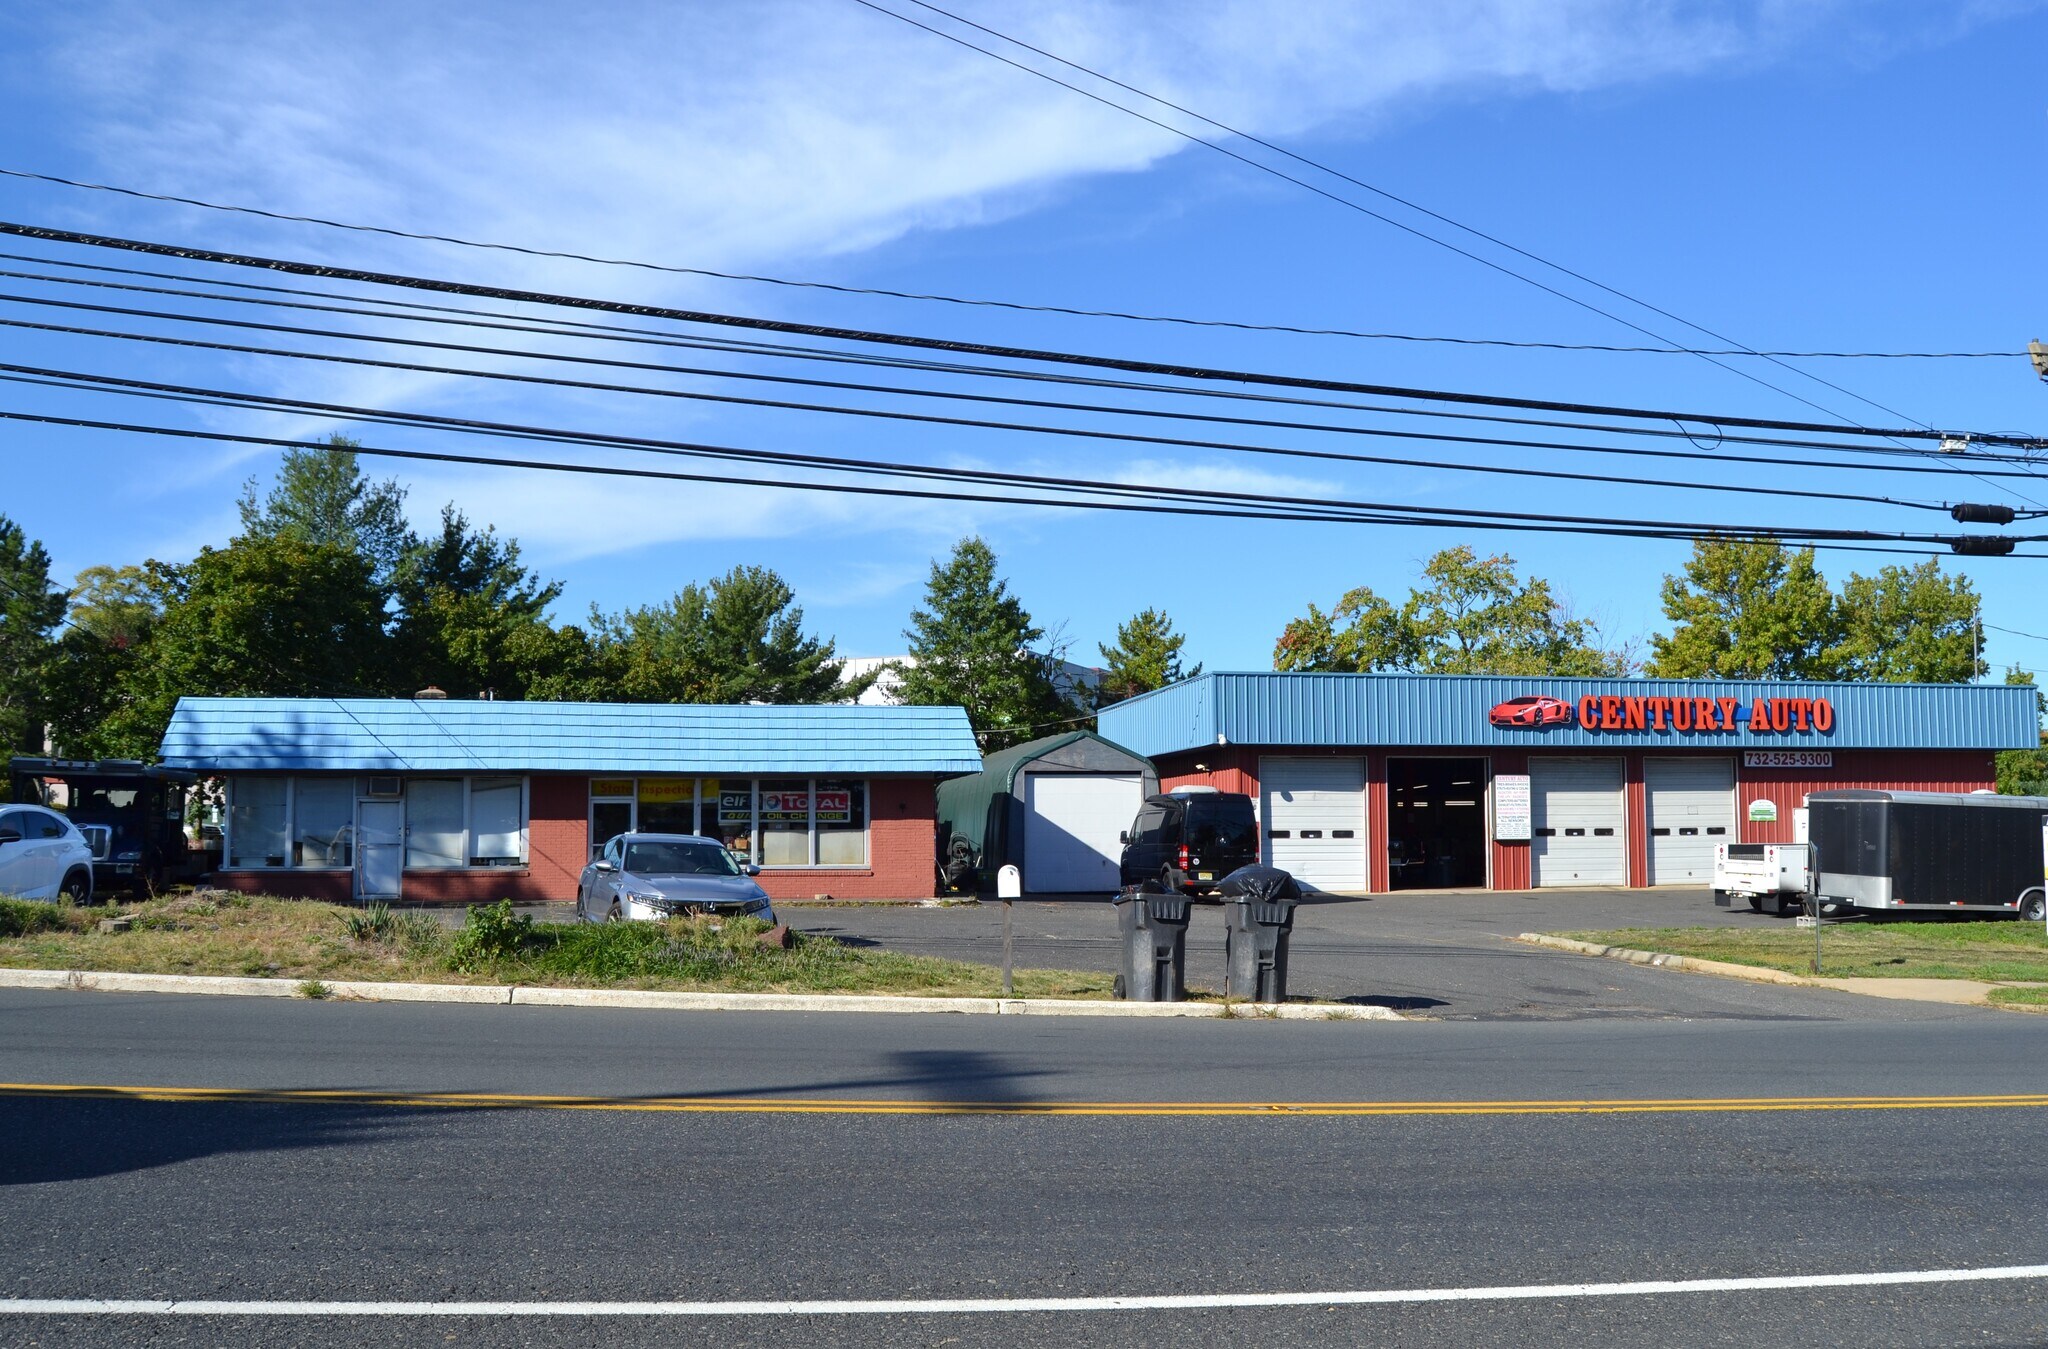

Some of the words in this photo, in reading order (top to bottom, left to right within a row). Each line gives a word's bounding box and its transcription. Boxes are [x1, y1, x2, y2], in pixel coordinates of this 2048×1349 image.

[1578, 695, 1738, 730] CENTURY
[1749, 698, 1833, 732] AUTO
[1745, 752, 1831, 766] 732-525-9300
[637, 783, 695, 797] Inspectio
[722, 795, 748, 807] elf
[784, 796, 846, 808] TOAL
[766, 812, 786, 820] OIL
[790, 812, 844, 820] CHNGE
